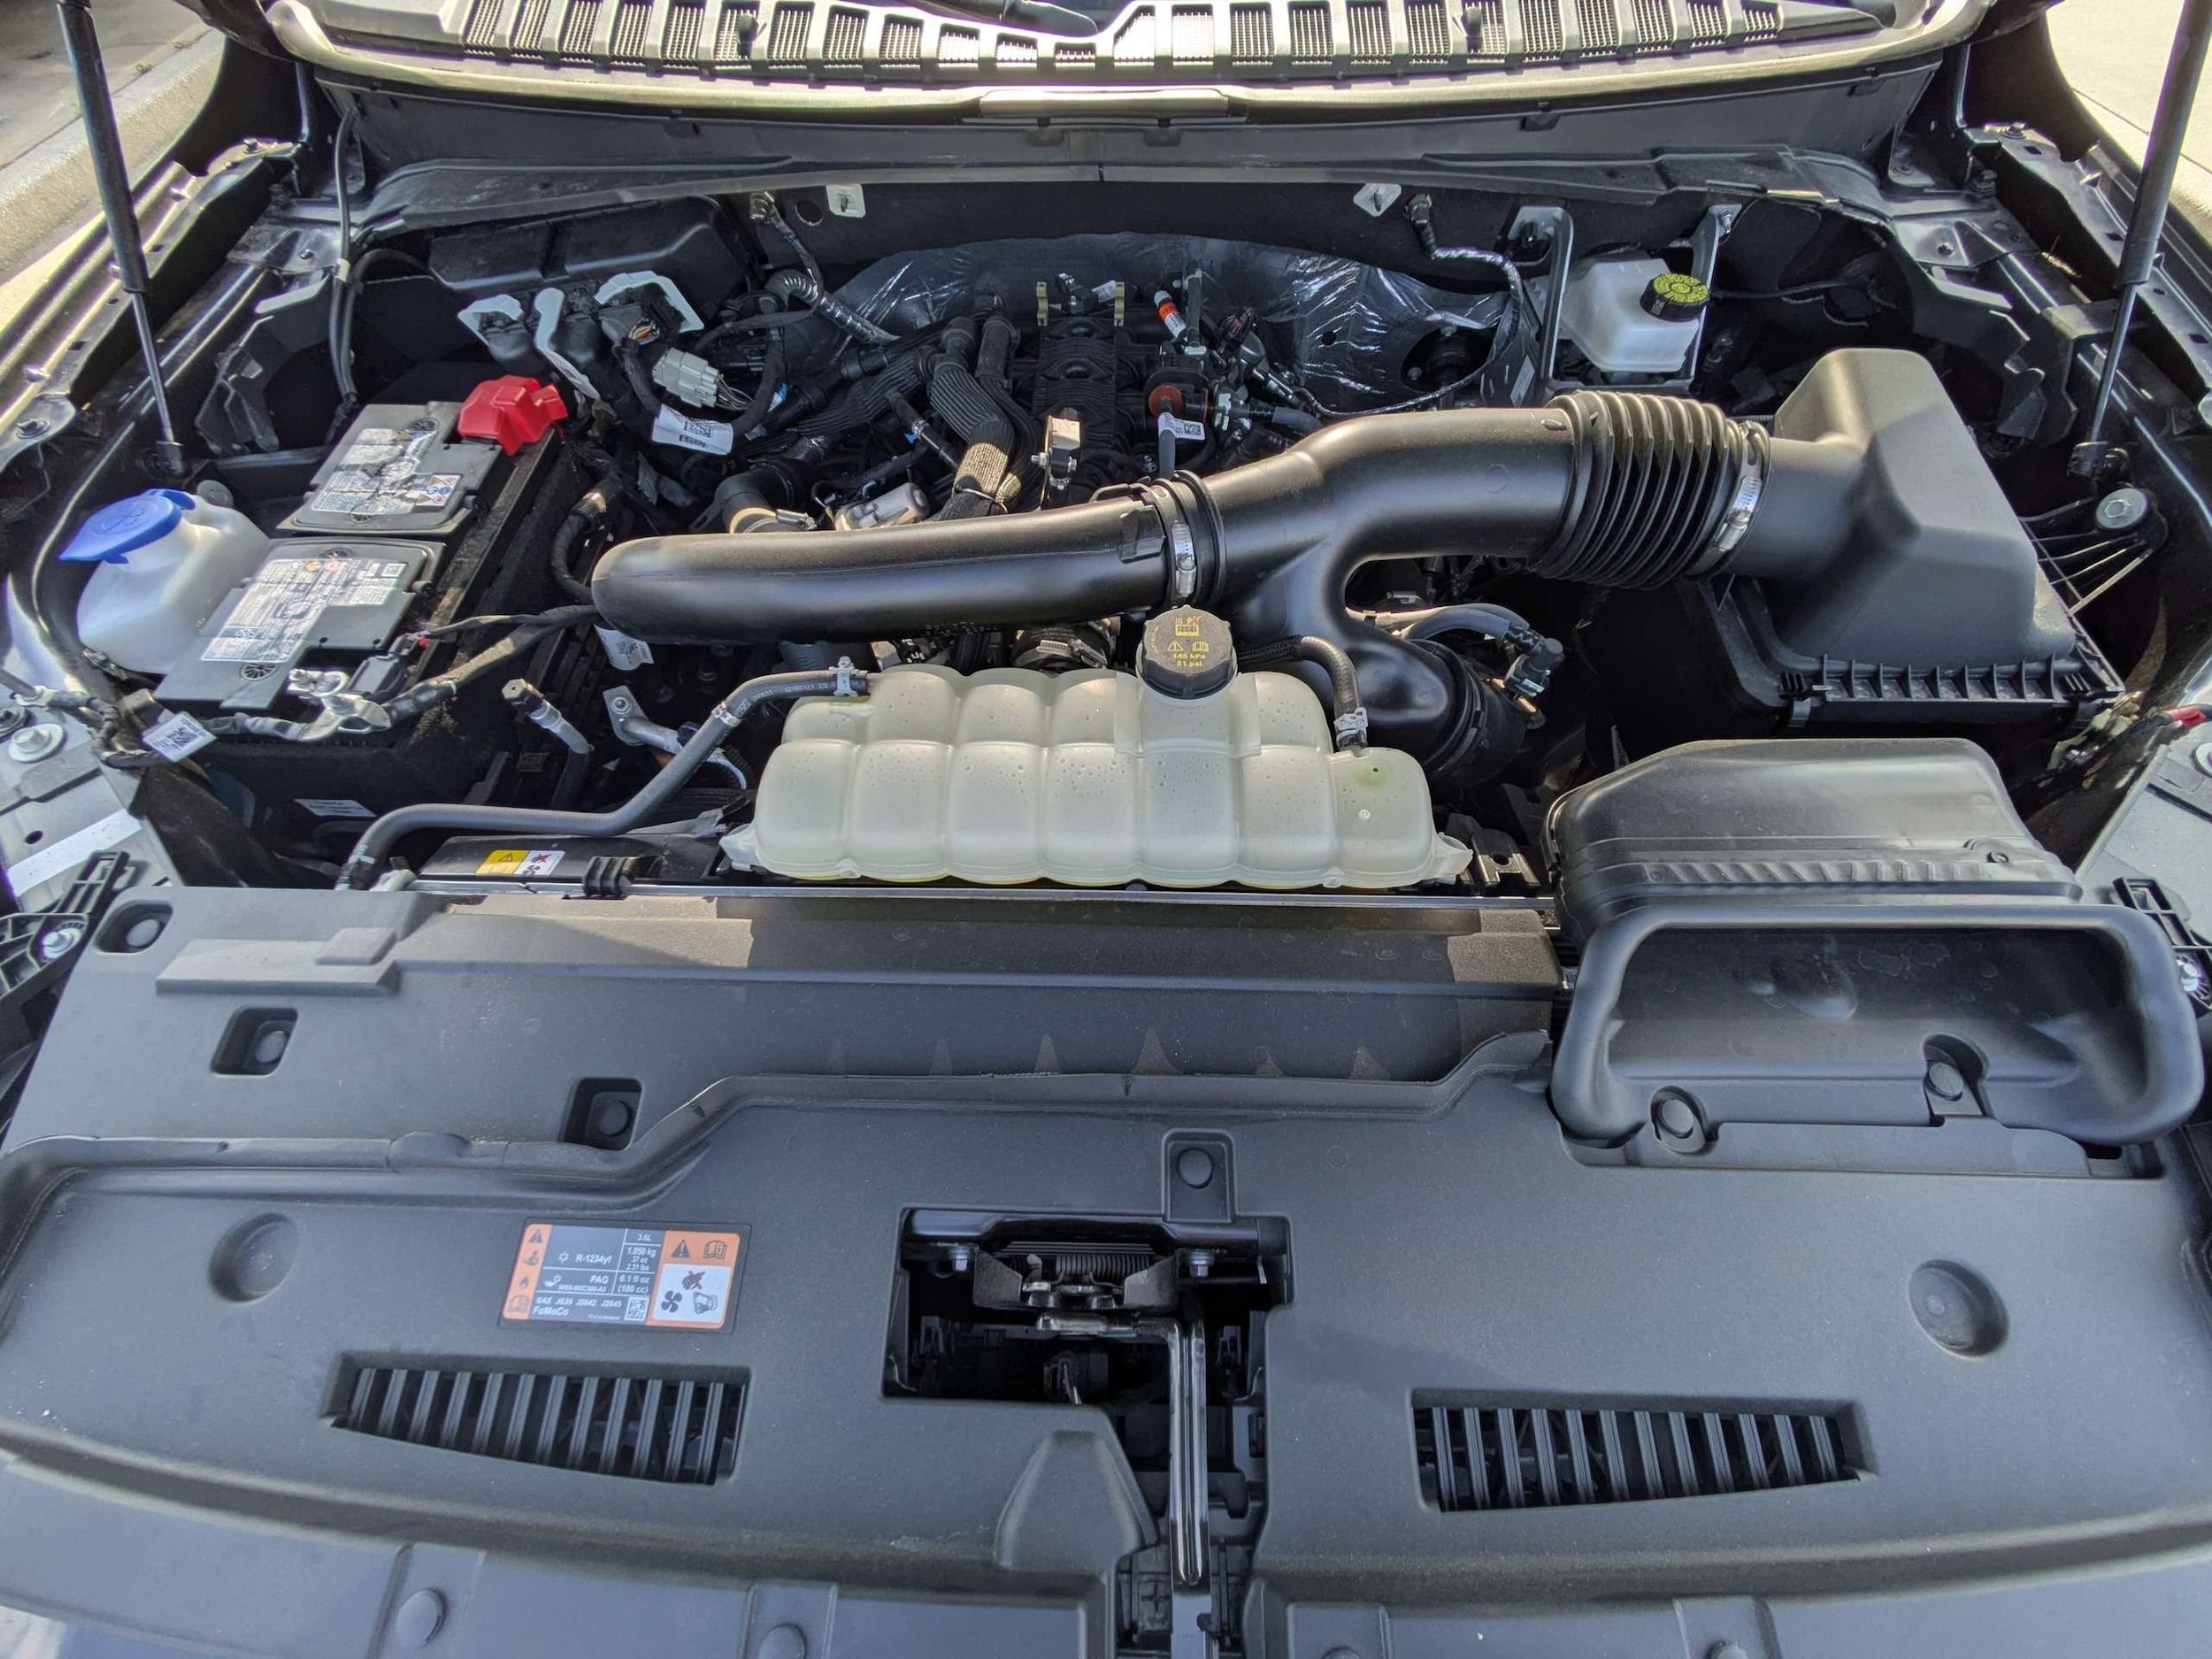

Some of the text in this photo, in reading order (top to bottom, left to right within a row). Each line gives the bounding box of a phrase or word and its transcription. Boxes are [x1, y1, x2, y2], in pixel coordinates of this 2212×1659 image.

[626, 1247, 657, 1257] 1.050 kg
[574, 1253, 613, 1264] R-1234yf
[589, 1274, 609, 1284] PAG
[617, 1285, 634, 1294] (180
[535, 1296, 553, 1305] SAE
[555, 1296, 572, 1306] J639
[532, 1305, 570, 1316] FoMoCo
